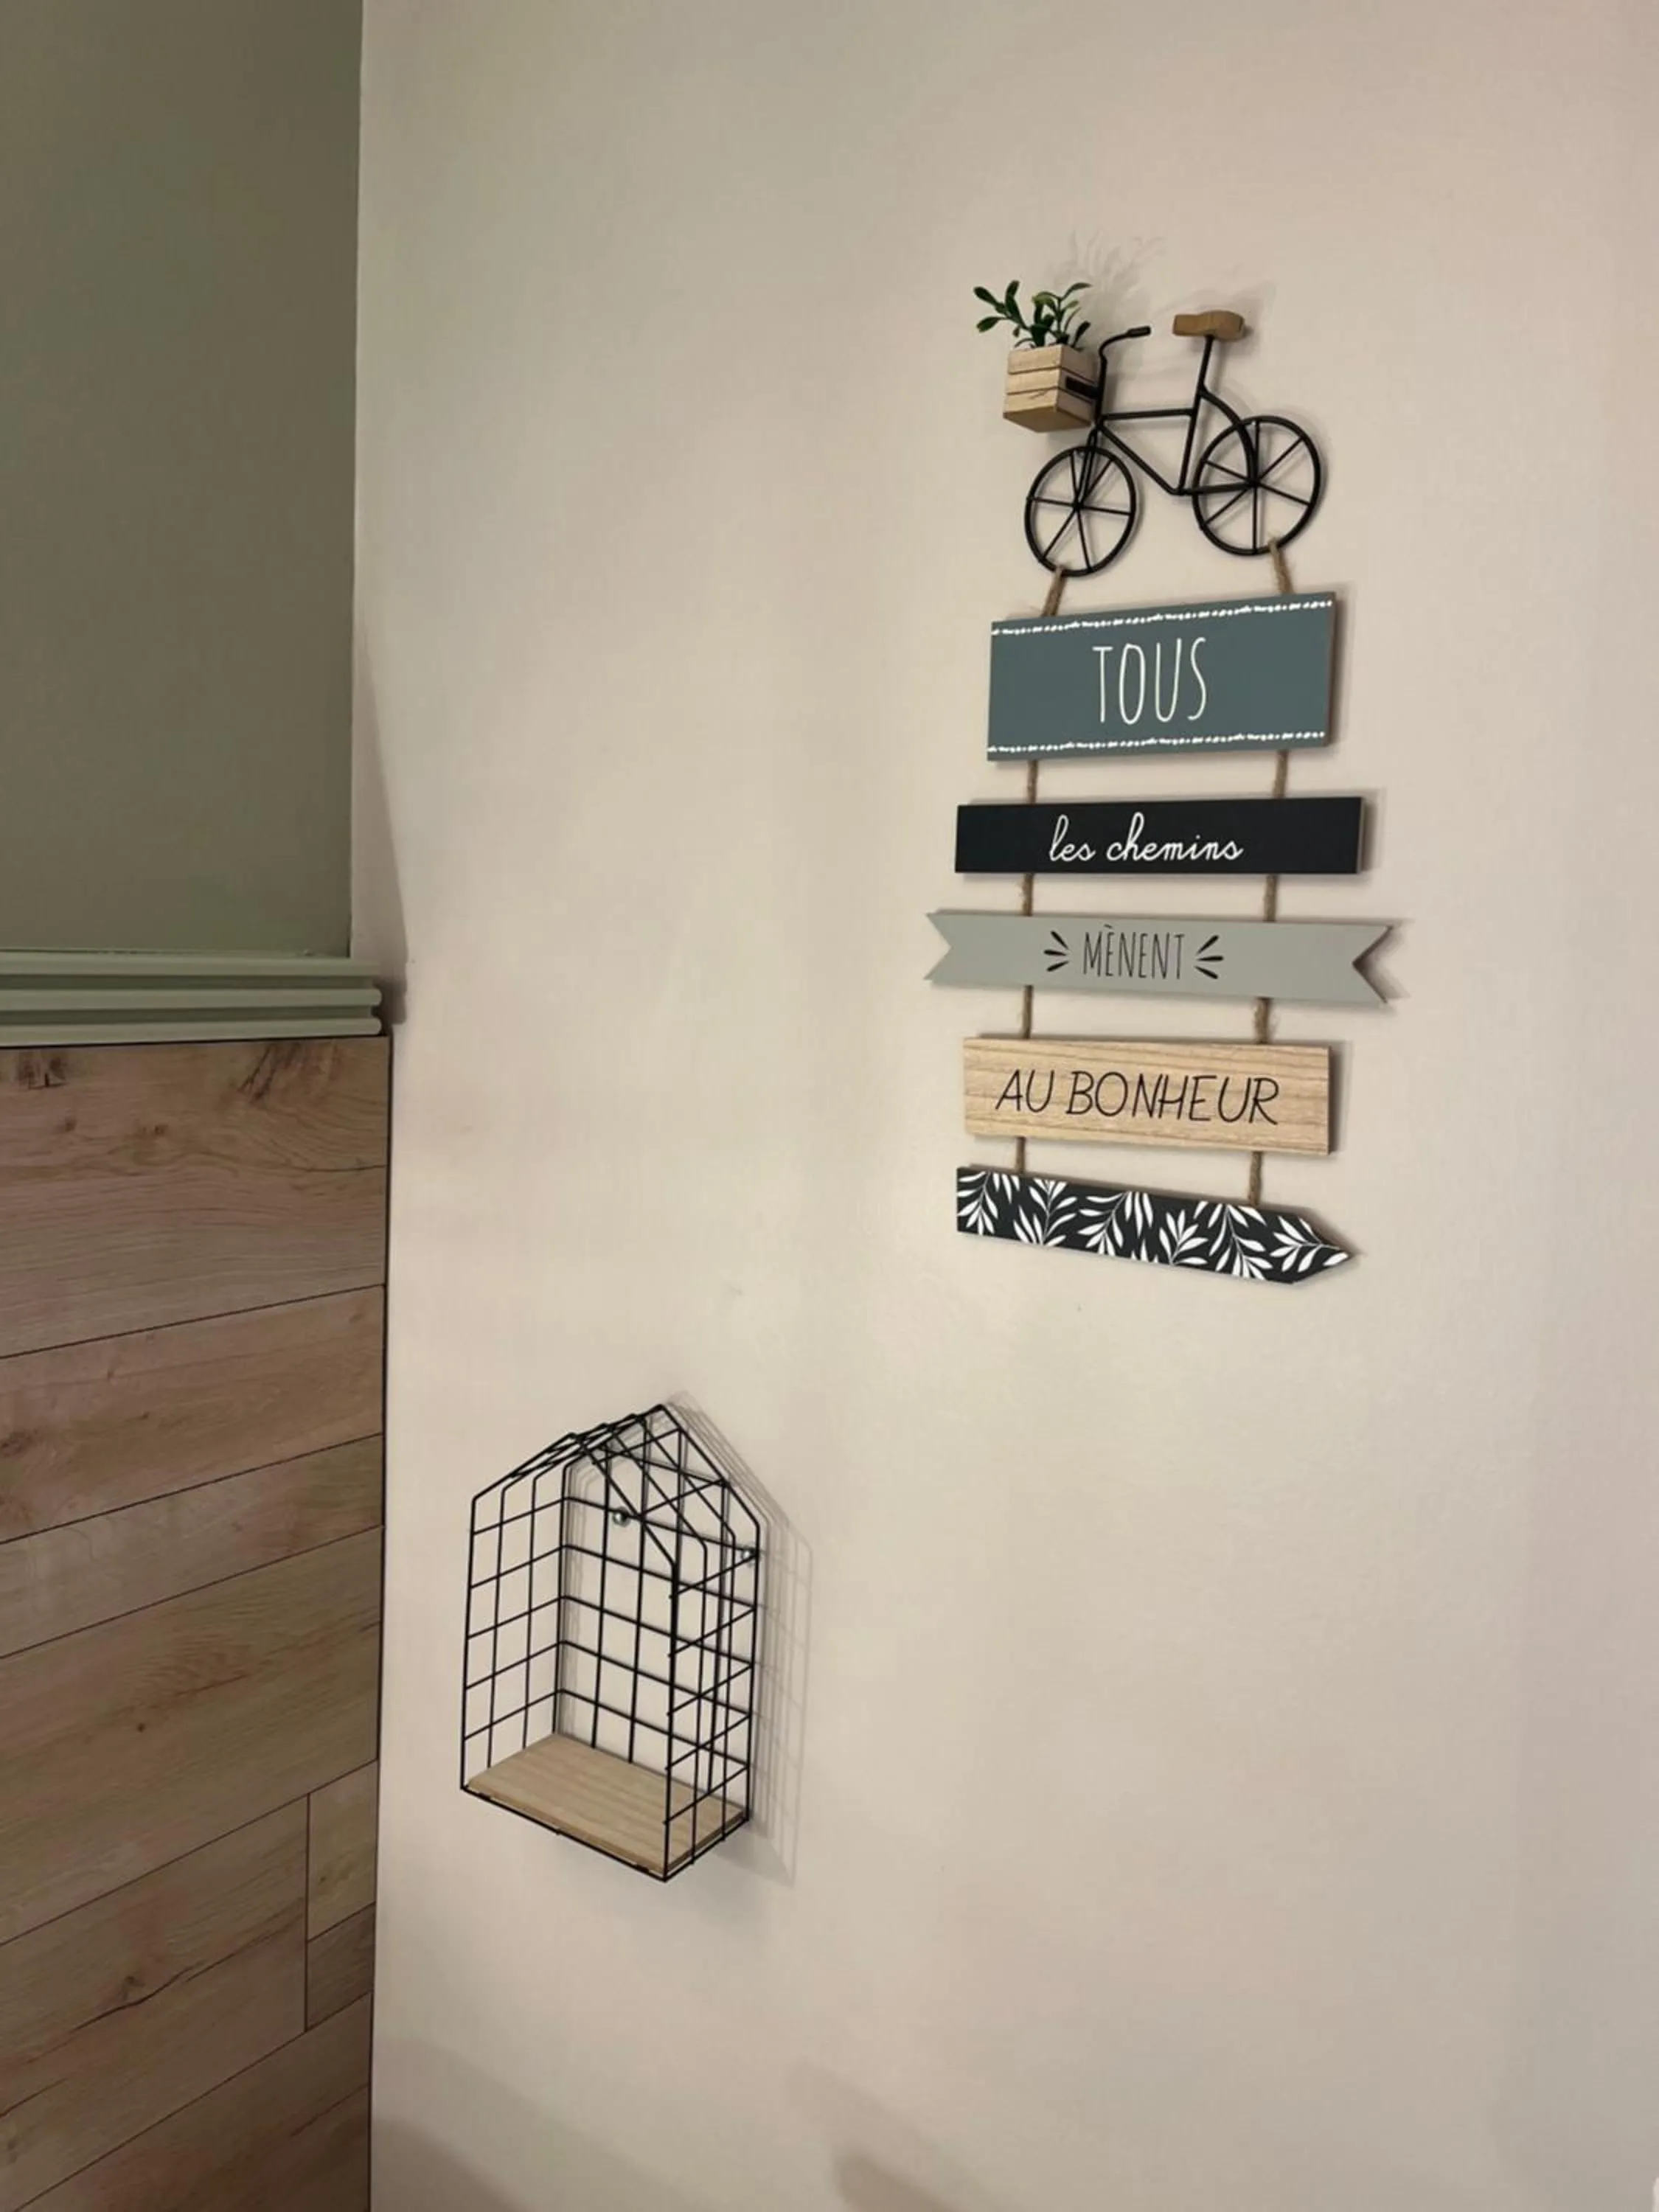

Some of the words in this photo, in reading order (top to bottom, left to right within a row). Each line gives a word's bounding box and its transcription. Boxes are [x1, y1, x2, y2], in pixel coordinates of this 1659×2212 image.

[1092, 636, 1208, 726] TOUS
[1048, 814, 1096, 862] les
[1106, 812, 1244, 861] chemins
[1082, 924, 1186, 979] MÈNENT
[995, 1069, 1055, 1113] AU
[1065, 1071, 1280, 1125] BONHEUR
